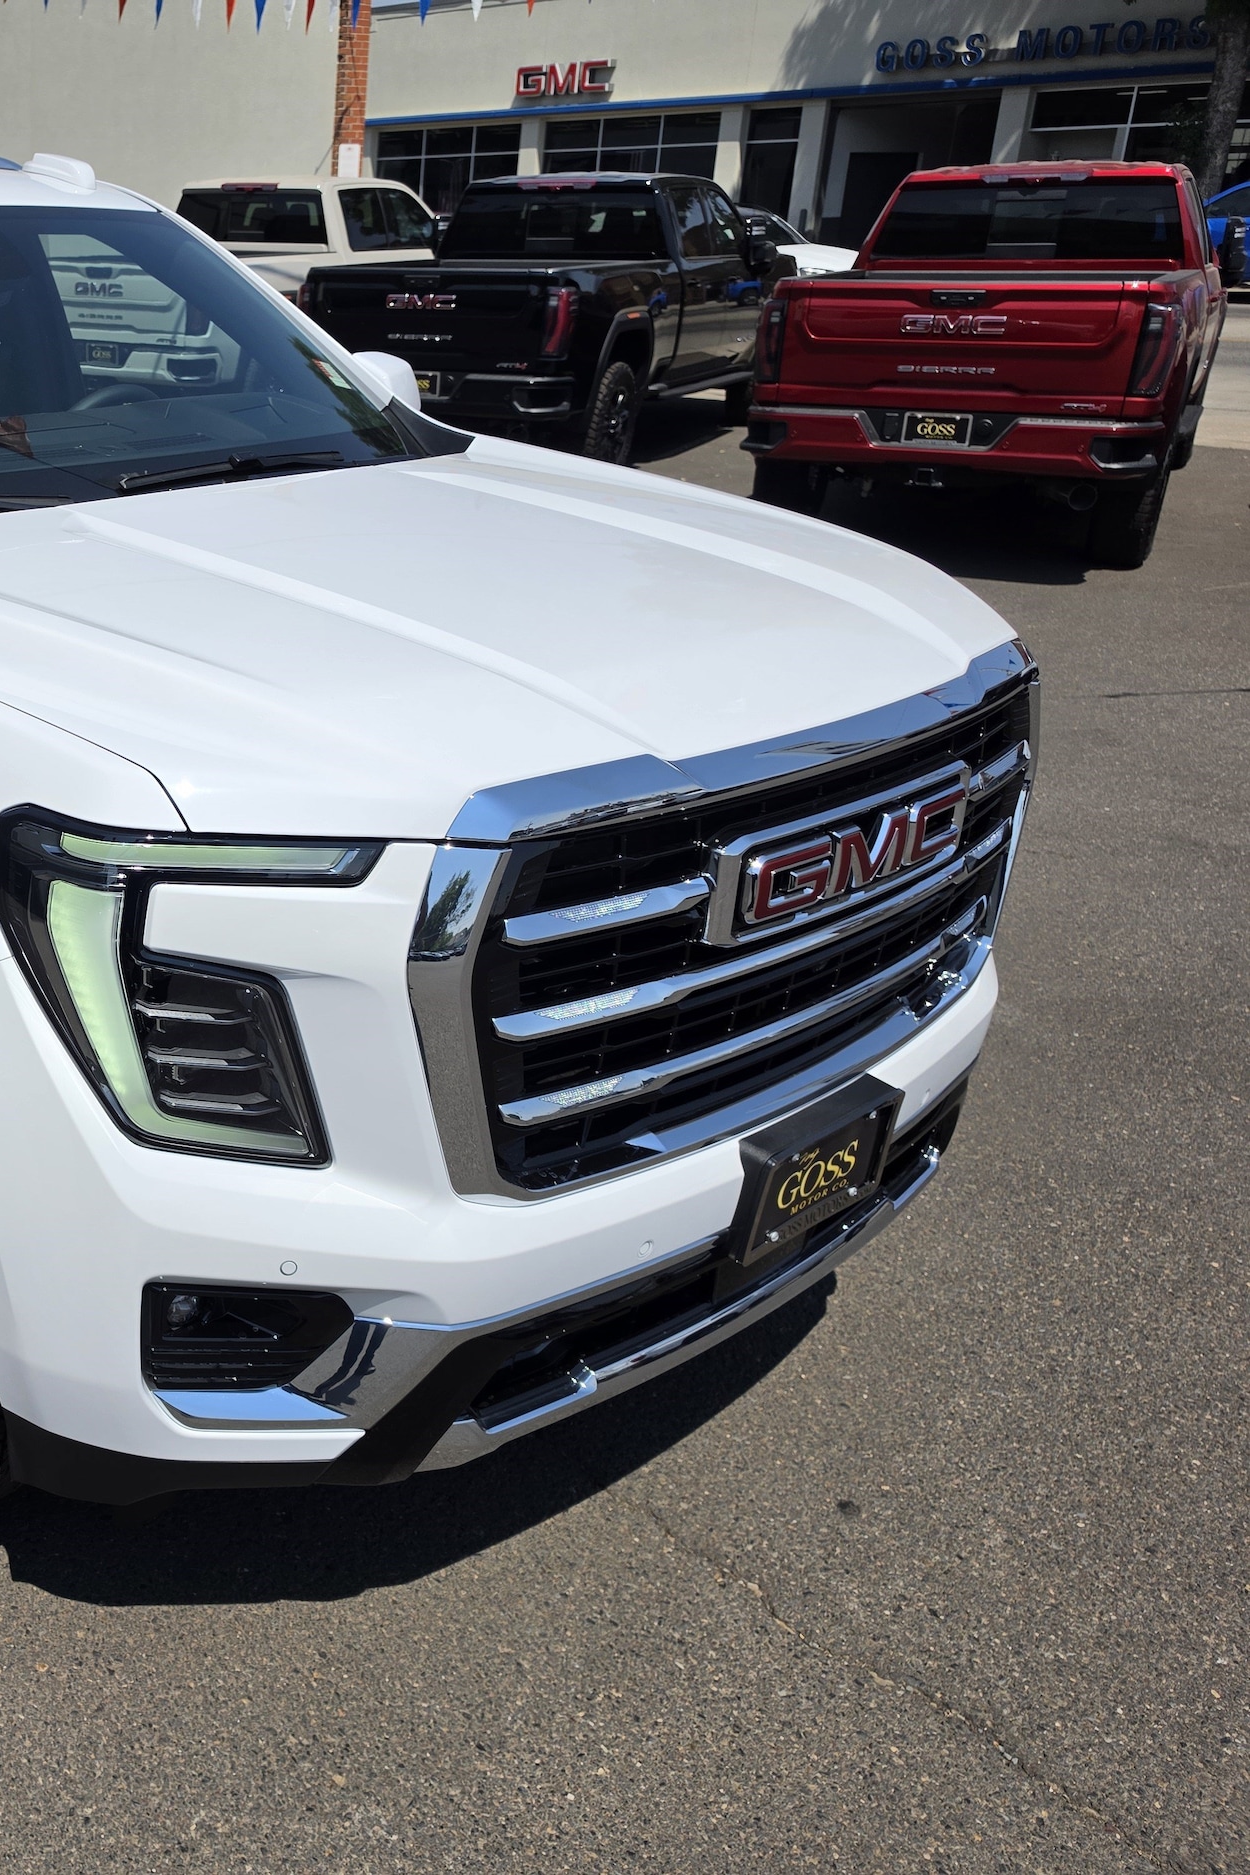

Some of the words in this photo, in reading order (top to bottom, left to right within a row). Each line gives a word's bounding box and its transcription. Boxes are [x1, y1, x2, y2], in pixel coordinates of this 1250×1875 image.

[875, 33, 987, 73] GOSS
[1014, 15, 1210, 62] MOTORS
[515, 59, 612, 97] GMC
[75, 282, 123, 297] GMC
[386, 293, 457, 310] GMC
[900, 314, 1007, 334] GMC
[897, 365, 995, 375] SIERRA
[916, 423, 956, 436] GOSS
[744, 783, 968, 924] GMC
[777, 1139, 859, 1210] GOSS
[790, 1188, 829, 1215] MOTOR
[832, 1179, 849, 1192] CO.
